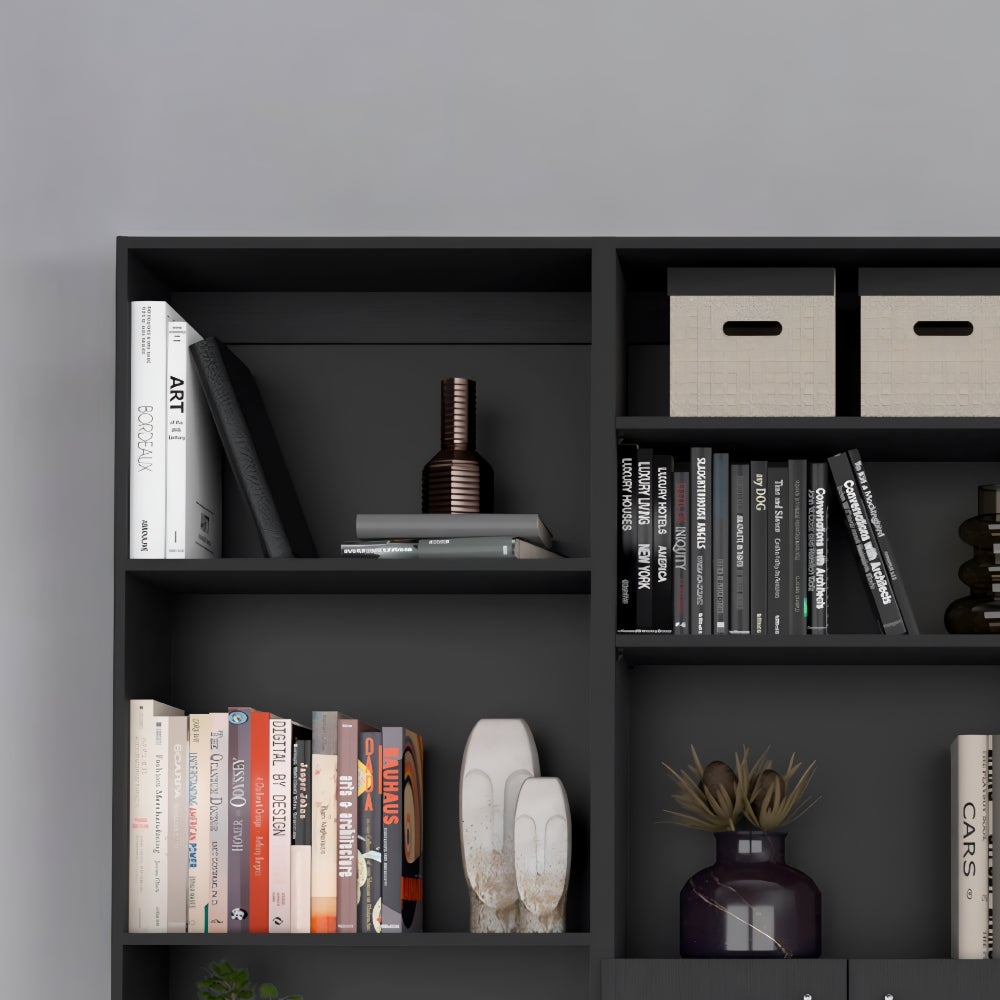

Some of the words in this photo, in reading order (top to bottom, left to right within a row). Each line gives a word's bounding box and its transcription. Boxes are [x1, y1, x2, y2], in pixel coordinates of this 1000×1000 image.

[170, 376, 184, 413] ART
[138, 406, 153, 472] BORDEAUX
[622, 458, 632, 493] LUXURY
[638, 462, 650, 496] LUXURY
[622, 495, 632, 531] HOUSES
[638, 498, 650, 525] LIVING
[756, 488, 766, 511] DOG
[844, 480, 871, 541] Conversations
[658, 502, 667, 535] HOTELS
[638, 544, 650, 564] NEW
[863, 541, 878, 561] with
[638, 565, 650, 589] YORK
[869, 561, 892, 605] Architects
[273, 721, 286, 766] DIGITAL
[273, 774, 286, 787] BY
[298, 763, 307, 791] Jasper
[383, 748, 399, 825] BAUHAUS
[273, 795, 286, 836] DESIGN
[189, 843, 198, 868] POWER
[339, 813, 355, 877] architecture
[963, 802, 976, 877] CARS
